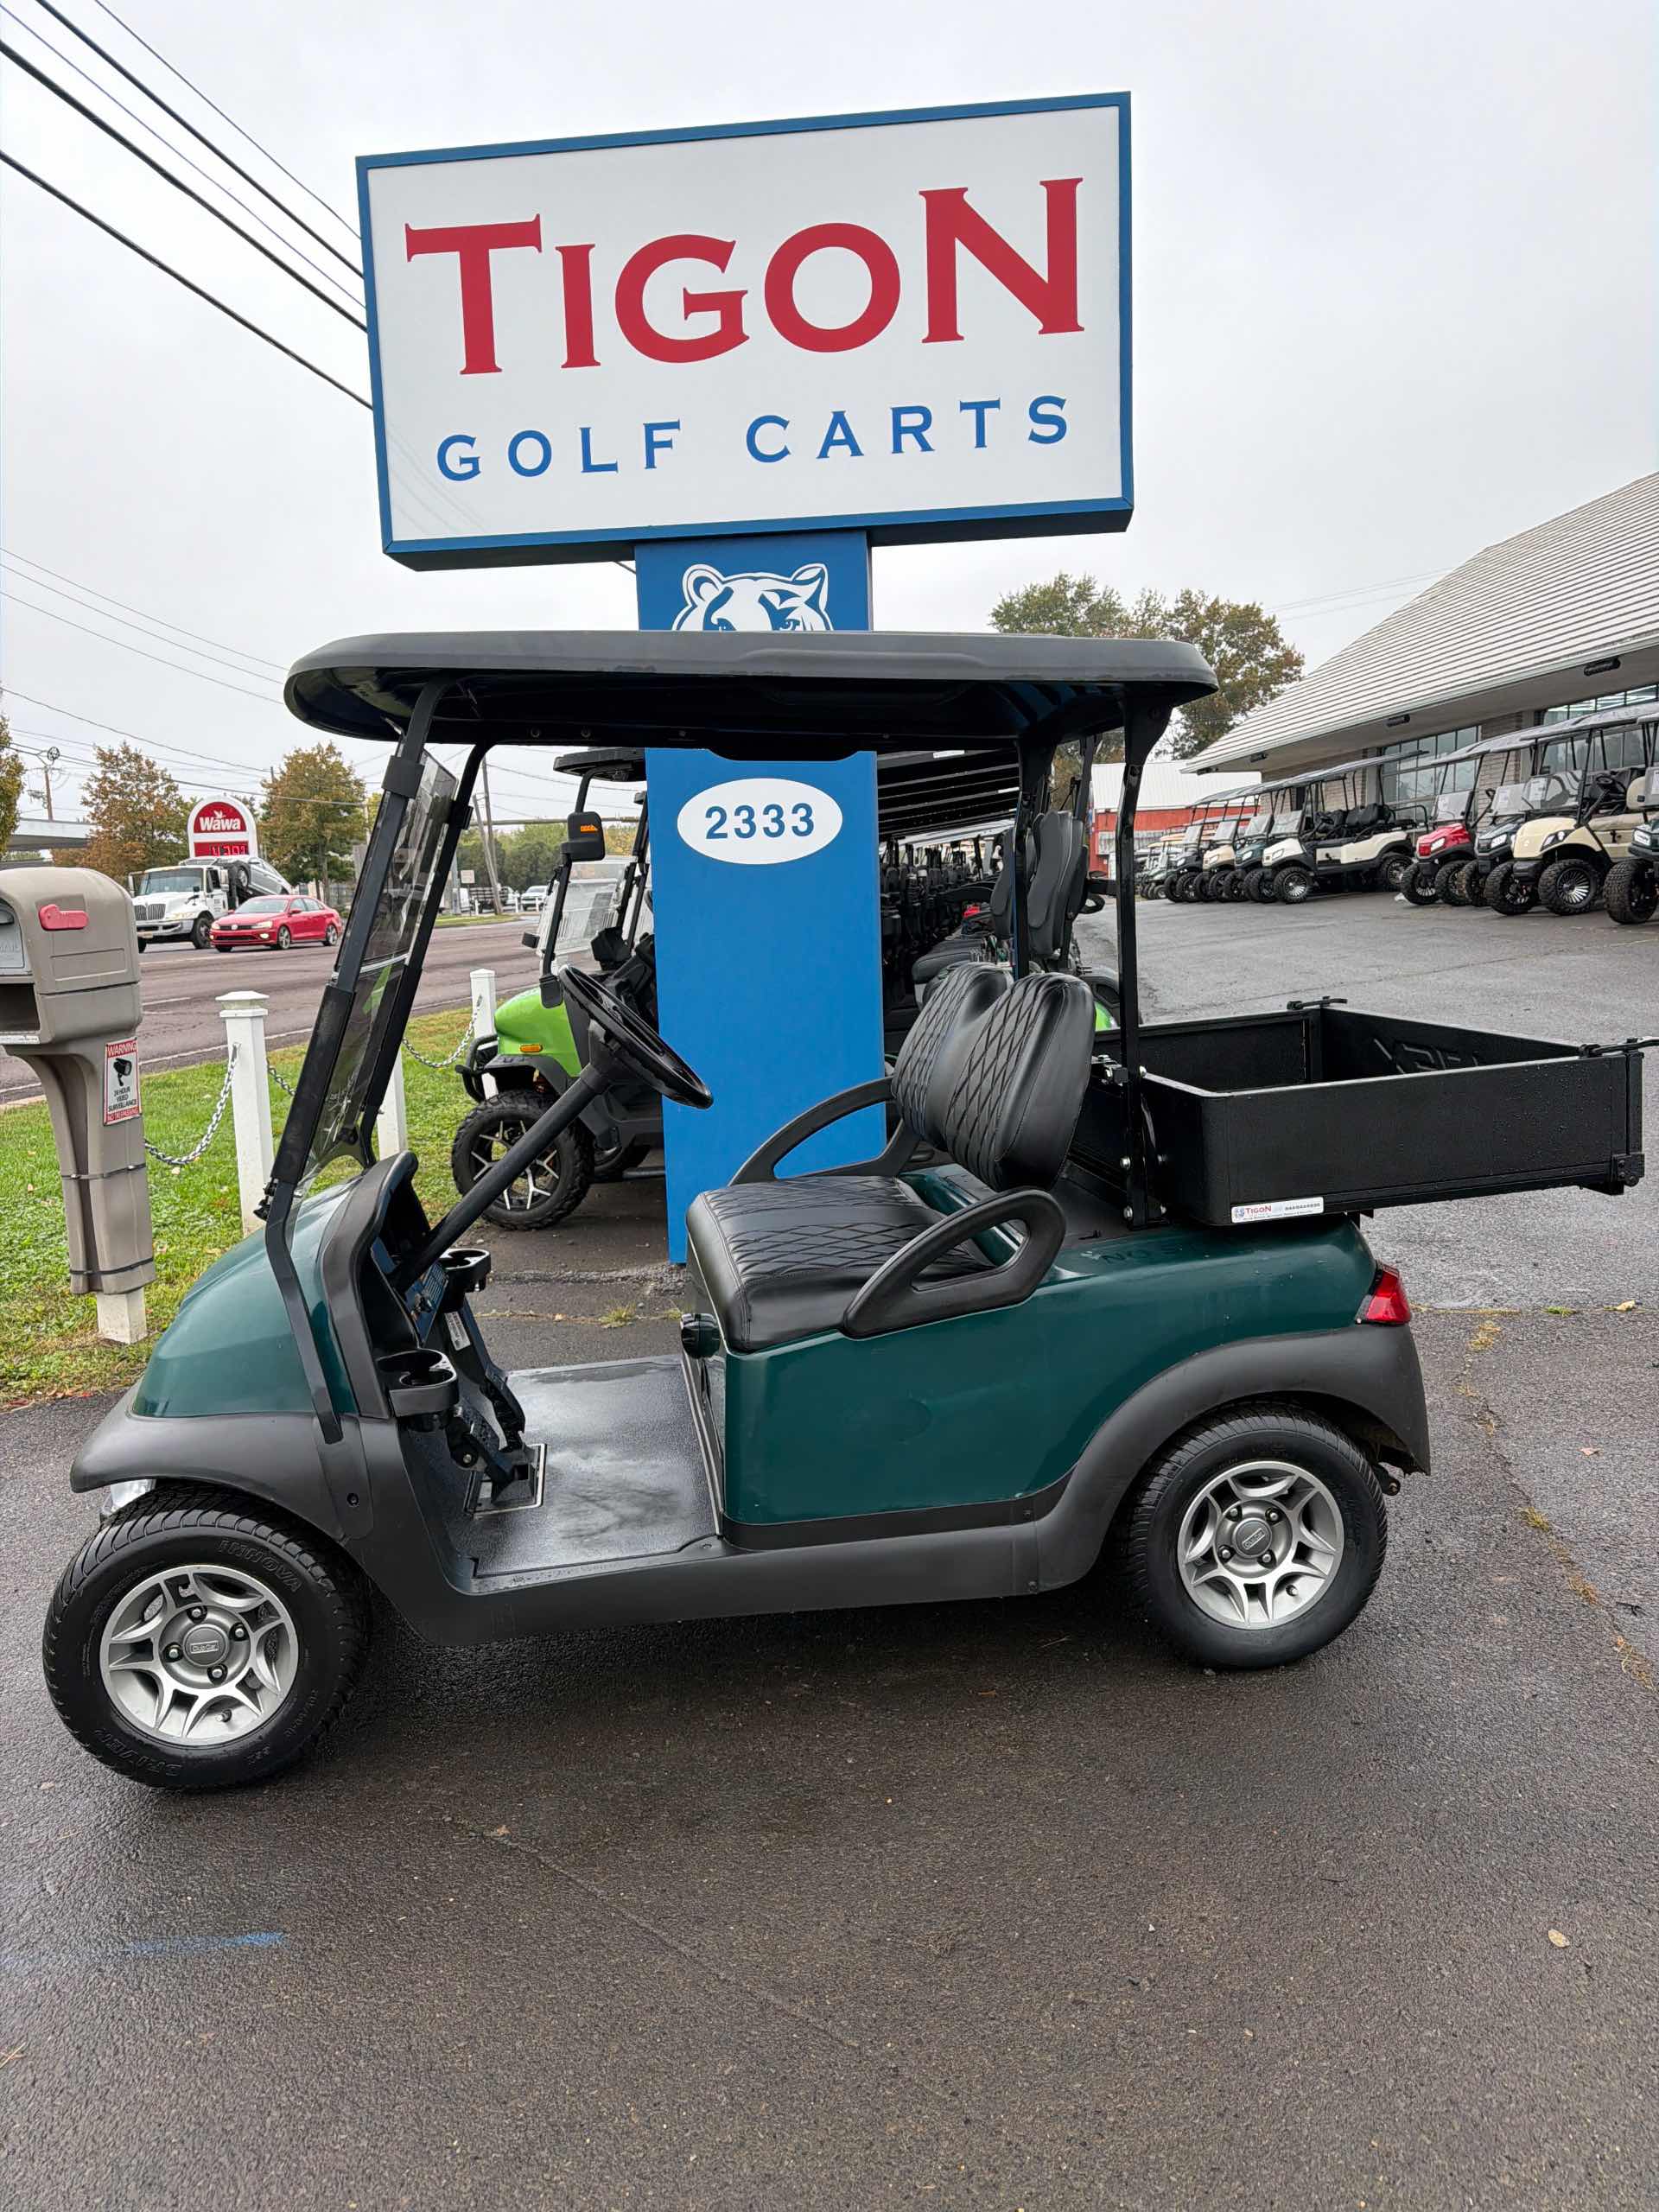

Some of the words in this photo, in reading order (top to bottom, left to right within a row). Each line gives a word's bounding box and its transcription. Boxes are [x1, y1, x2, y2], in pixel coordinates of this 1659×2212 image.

[404, 177, 1085, 375] TIGON
[436, 419, 681, 482] GOLF
[746, 395, 1069, 463] CARTS
[199, 817, 241, 831] Wawa
[705, 803, 814, 839] 2333
[107, 1040, 137, 1056] WARNING
[120, 1086, 130, 1095] HOUR
[108, 1099, 137, 1112] SURVEILLANCE
[116, 1094, 129, 1103] VIDEO
